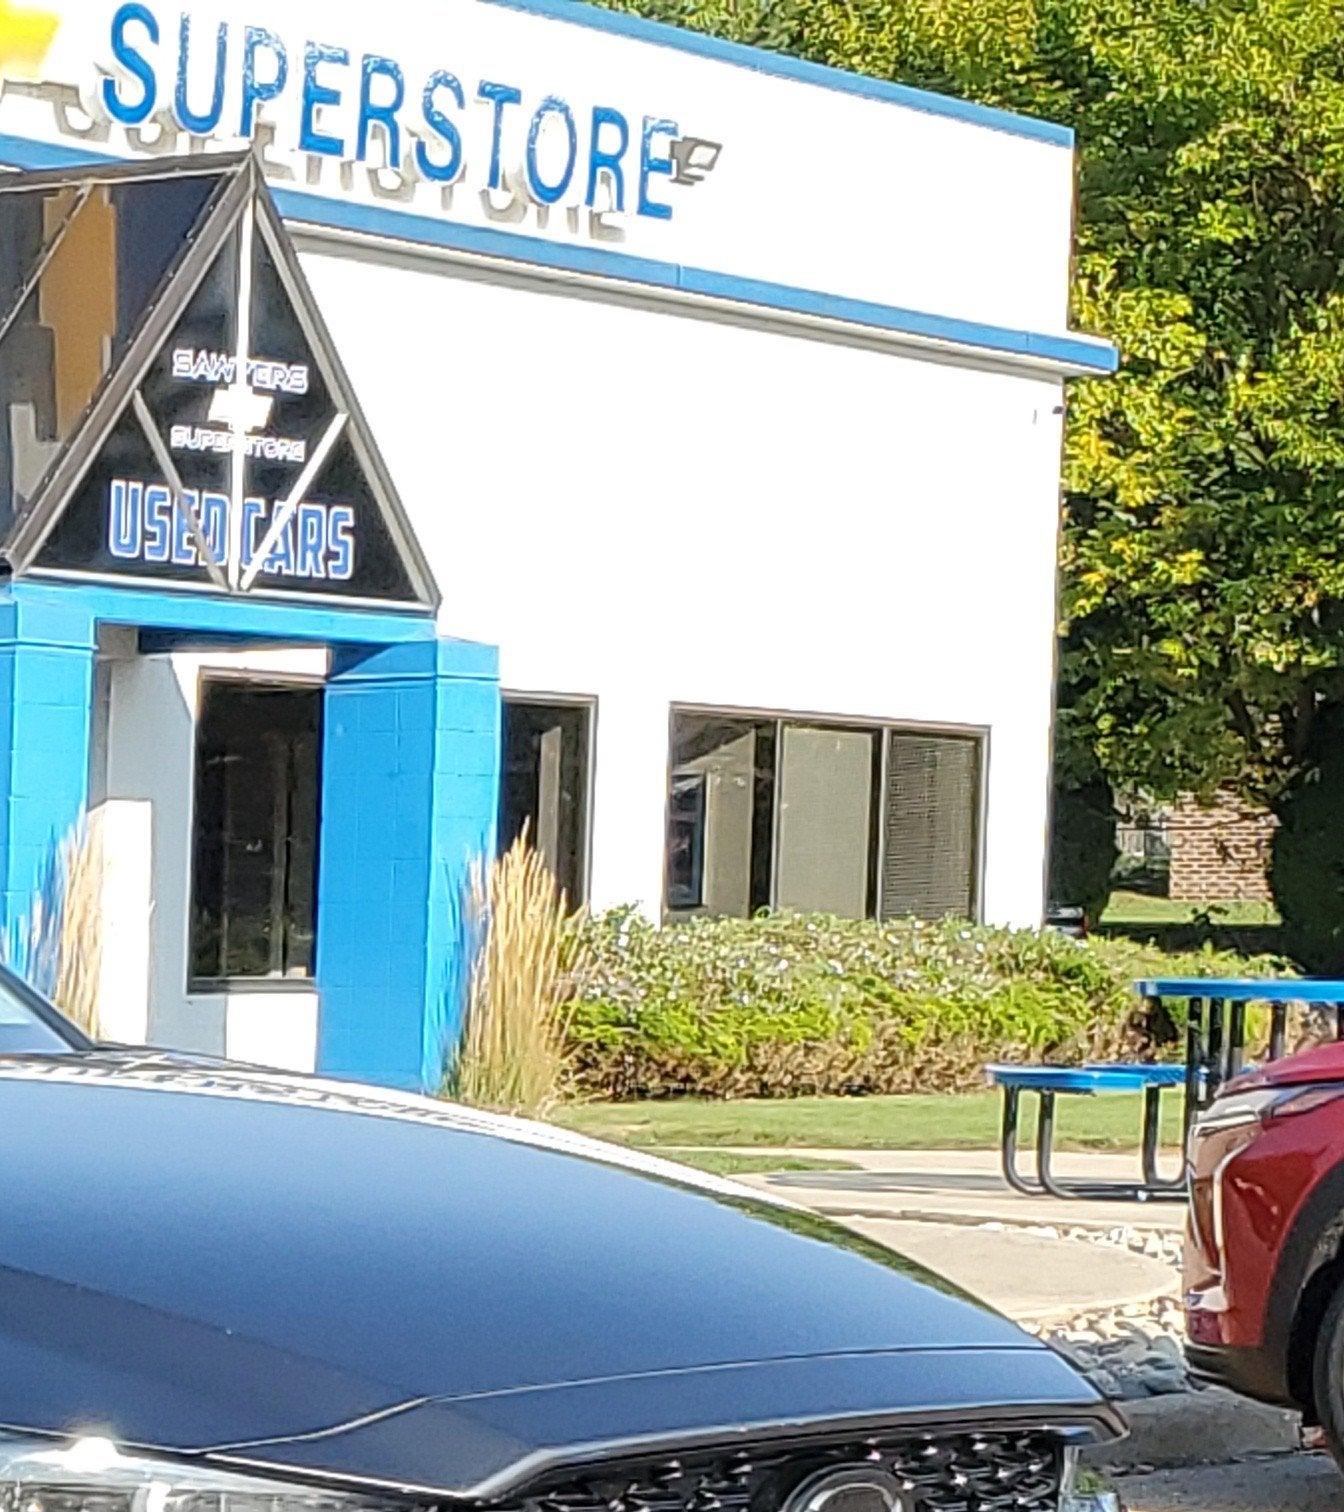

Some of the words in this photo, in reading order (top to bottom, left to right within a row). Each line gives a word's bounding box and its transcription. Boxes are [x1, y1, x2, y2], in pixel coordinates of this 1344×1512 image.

[102, 1, 682, 220] SUPERSTORE
[109, 478, 231, 567] USED
[241, 496, 355, 580] CARS
